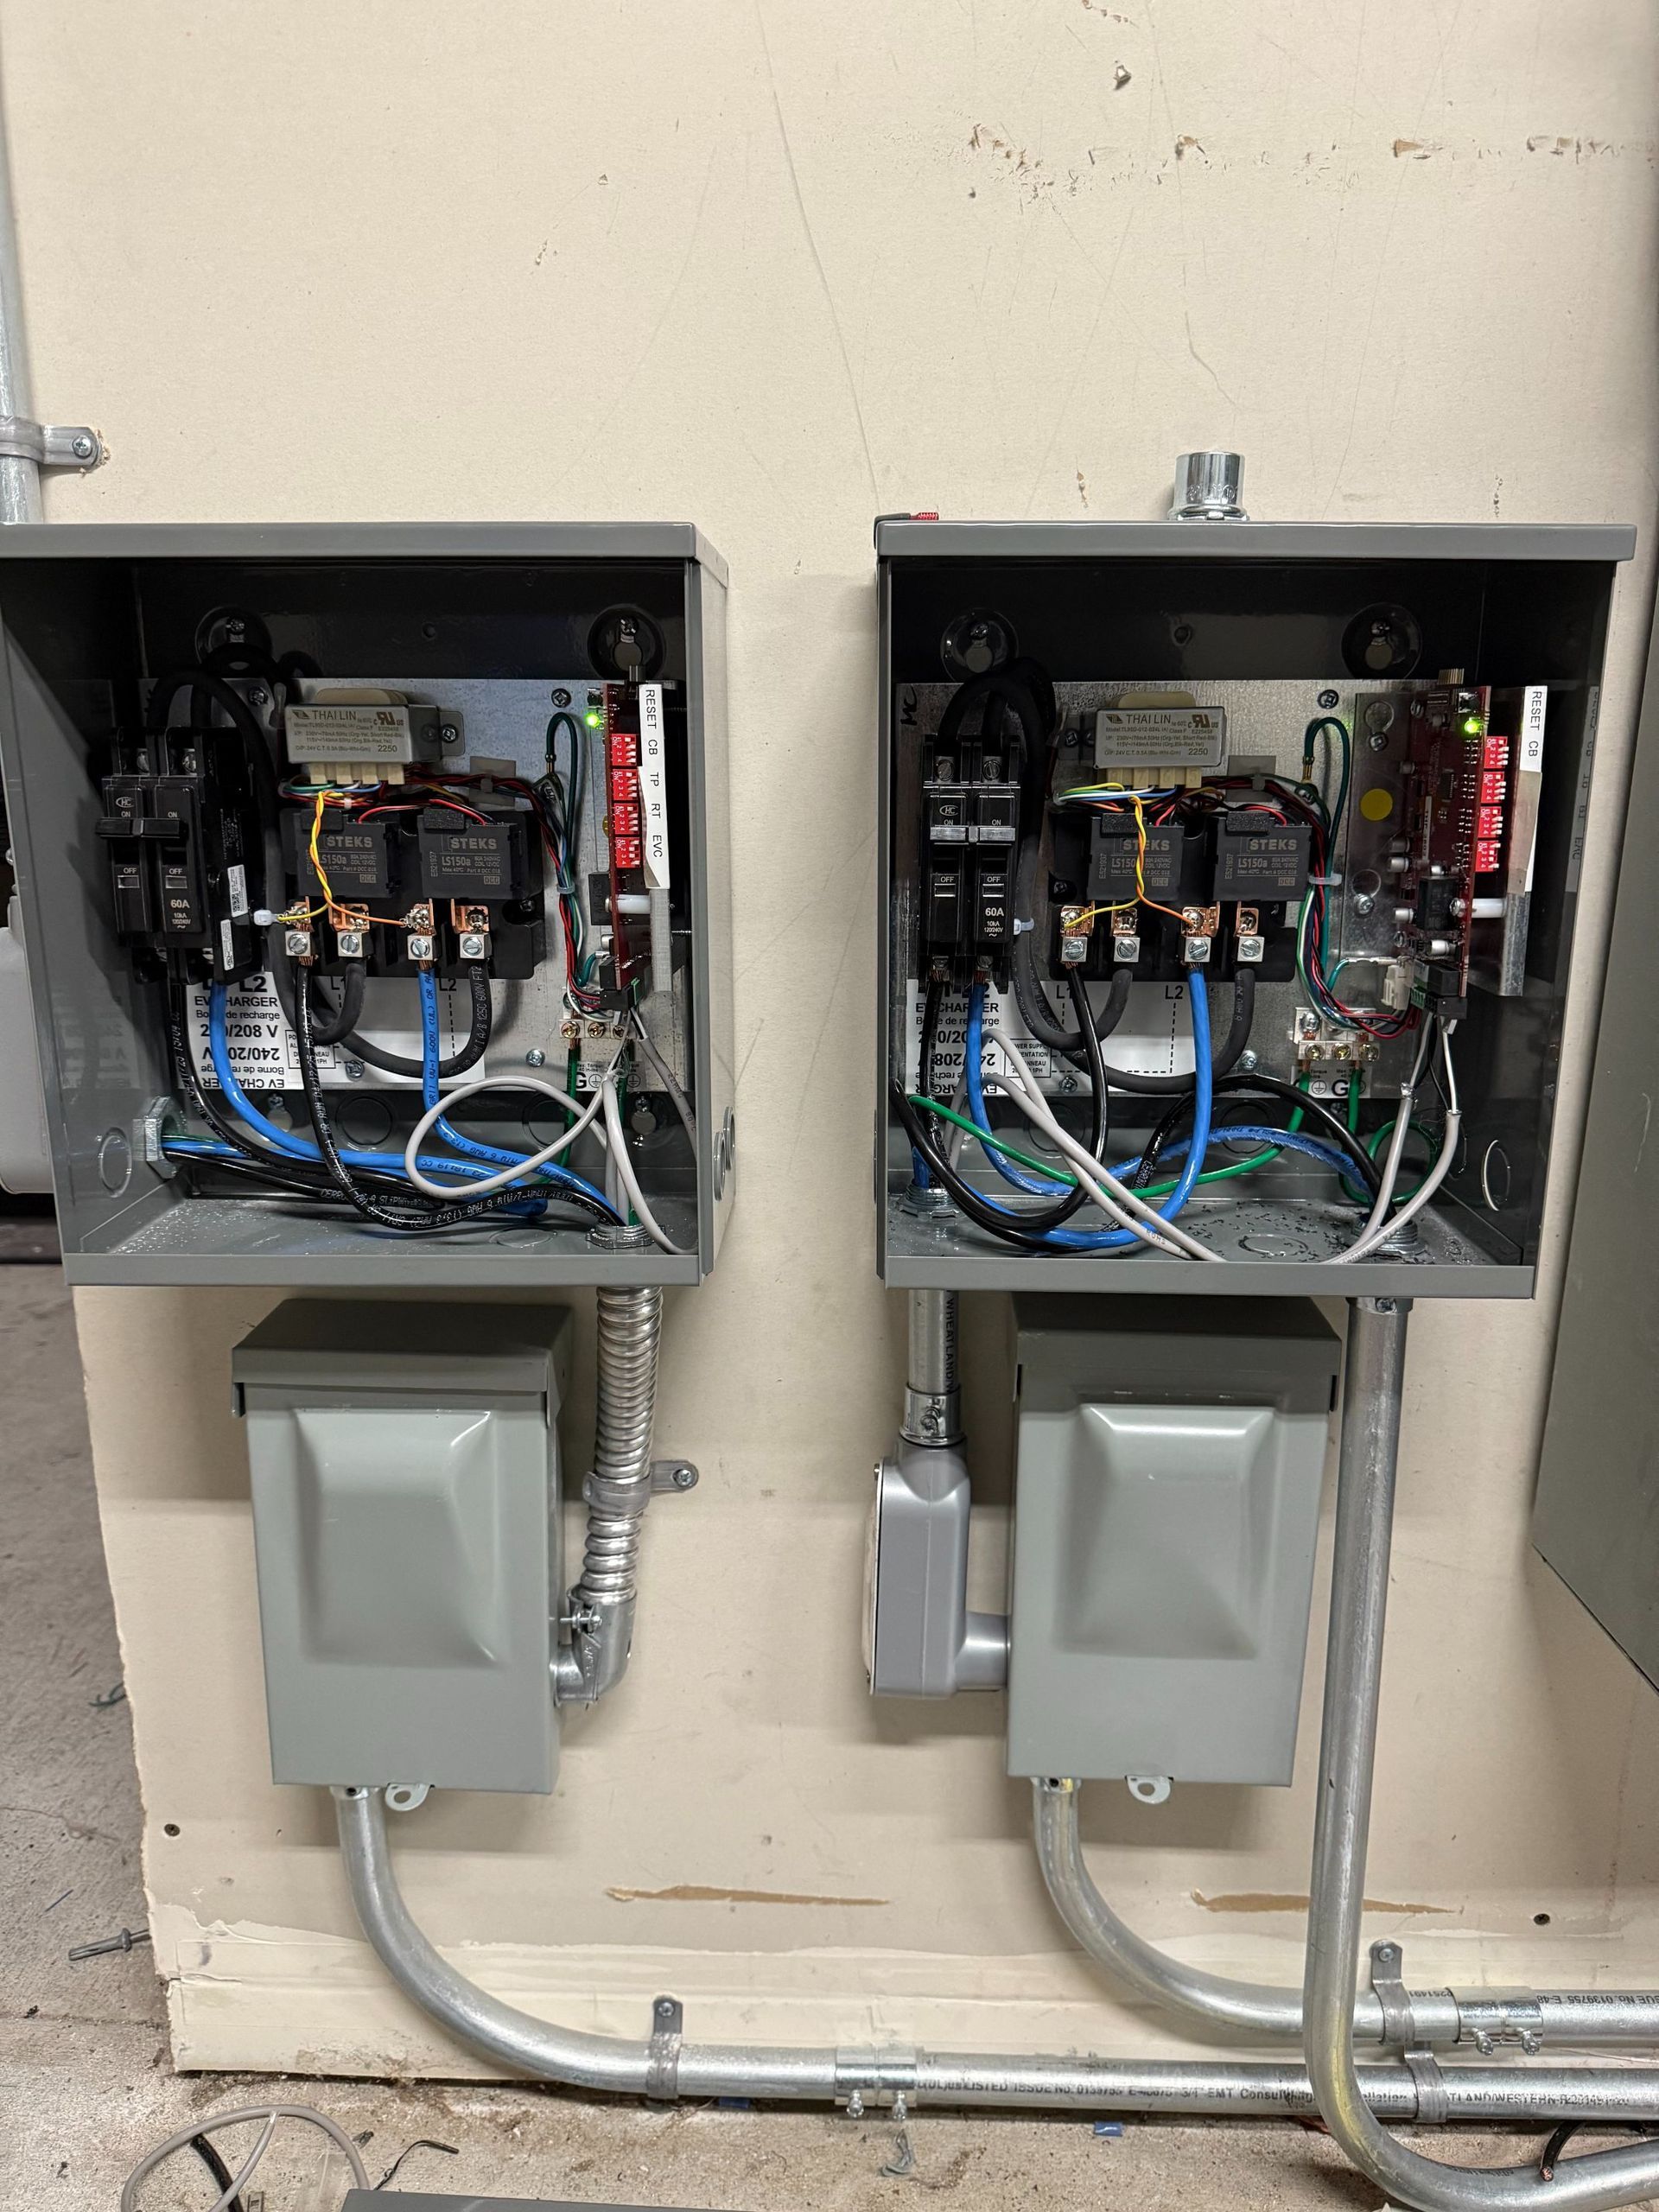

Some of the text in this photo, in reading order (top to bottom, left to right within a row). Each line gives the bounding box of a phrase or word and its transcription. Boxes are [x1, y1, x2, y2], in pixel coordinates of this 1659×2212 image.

[1529, 691, 1542, 757] RESET CB
[645, 690, 663, 858] RESET CB TP RT EVC
[327, 836, 372, 848] STEKS
[451, 838, 497, 849] STEKS
[1249, 839, 1297, 850] STEKS
[442, 856, 471, 866] LS150a
[1112, 858, 1135, 868] LS150
[1238, 858, 1268, 868] LS150a
[170, 899, 190, 908] 60A
[985, 907, 1004, 916] 60A
[474, 966, 483, 981] FT2
[439, 978, 457, 991] L2
[427, 989, 433, 1000] OR
[475, 982, 486, 1001] 600V
[1165, 986, 1184, 1000] L2
[226, 996, 277, 1007] HARGER
[939, 1003, 999, 1013] CHARER
[240, 1012, 280, 1021] recharge
[200, 1024, 278, 1037] 2/208 V
[228, 1047, 280, 1060] 240/20
[202, 1078, 284, 1088] EV CHAER
[1332, 1079, 1350, 1096] G
[945, 1297, 955, 1393] WHEATLAND/W
[1536, 1995, 1561, 2004] E-48
[1567, 1995, 1613, 2004] 0139755
[1637, 1995, 1659, 2004] SUE
[1208, 2088, 1233, 2099] EMT
